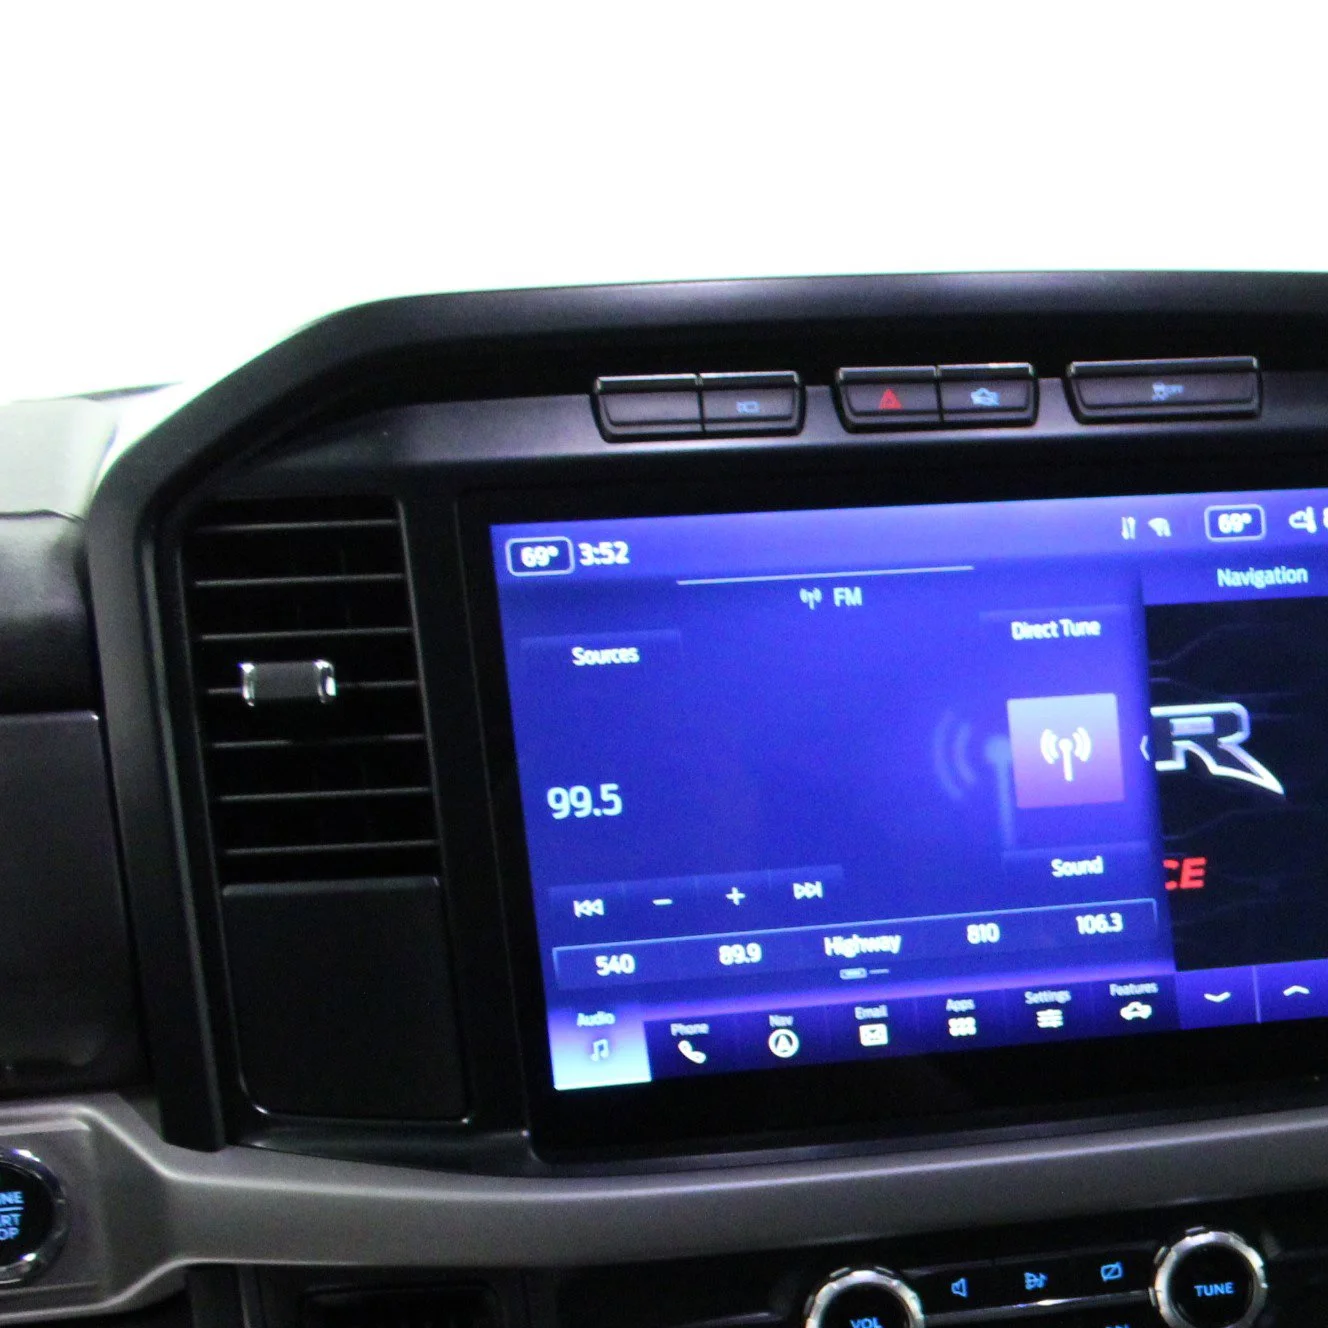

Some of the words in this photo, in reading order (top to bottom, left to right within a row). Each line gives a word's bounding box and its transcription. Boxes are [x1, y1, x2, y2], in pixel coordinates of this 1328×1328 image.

[578, 541, 631, 566] 3:52
[1217, 565, 1309, 590] Navigation
[833, 587, 863, 607] FM
[1011, 621, 1059, 641] Direct
[1060, 617, 1101, 637] Tune
[571, 646, 640, 667] Sources
[547, 784, 623, 820] 99.5
[1051, 856, 1104, 878] Sound
[966, 922, 1001, 944] 810
[1075, 912, 1124, 935] 106.3
[718, 942, 763, 967] 89.9
[824, 933, 901, 959] Highway
[595, 952, 636, 977] 540
[1024, 989, 1072, 1006] Settings
[1109, 980, 1159, 997] Features
[854, 1005, 889, 1021] Email
[945, 998, 976, 1014] Apps
[576, 1010, 616, 1028] Audio
[670, 1021, 710, 1037] Phone
[768, 1013, 794, 1028] Nav
[1194, 1280, 1235, 1297] TUNE
